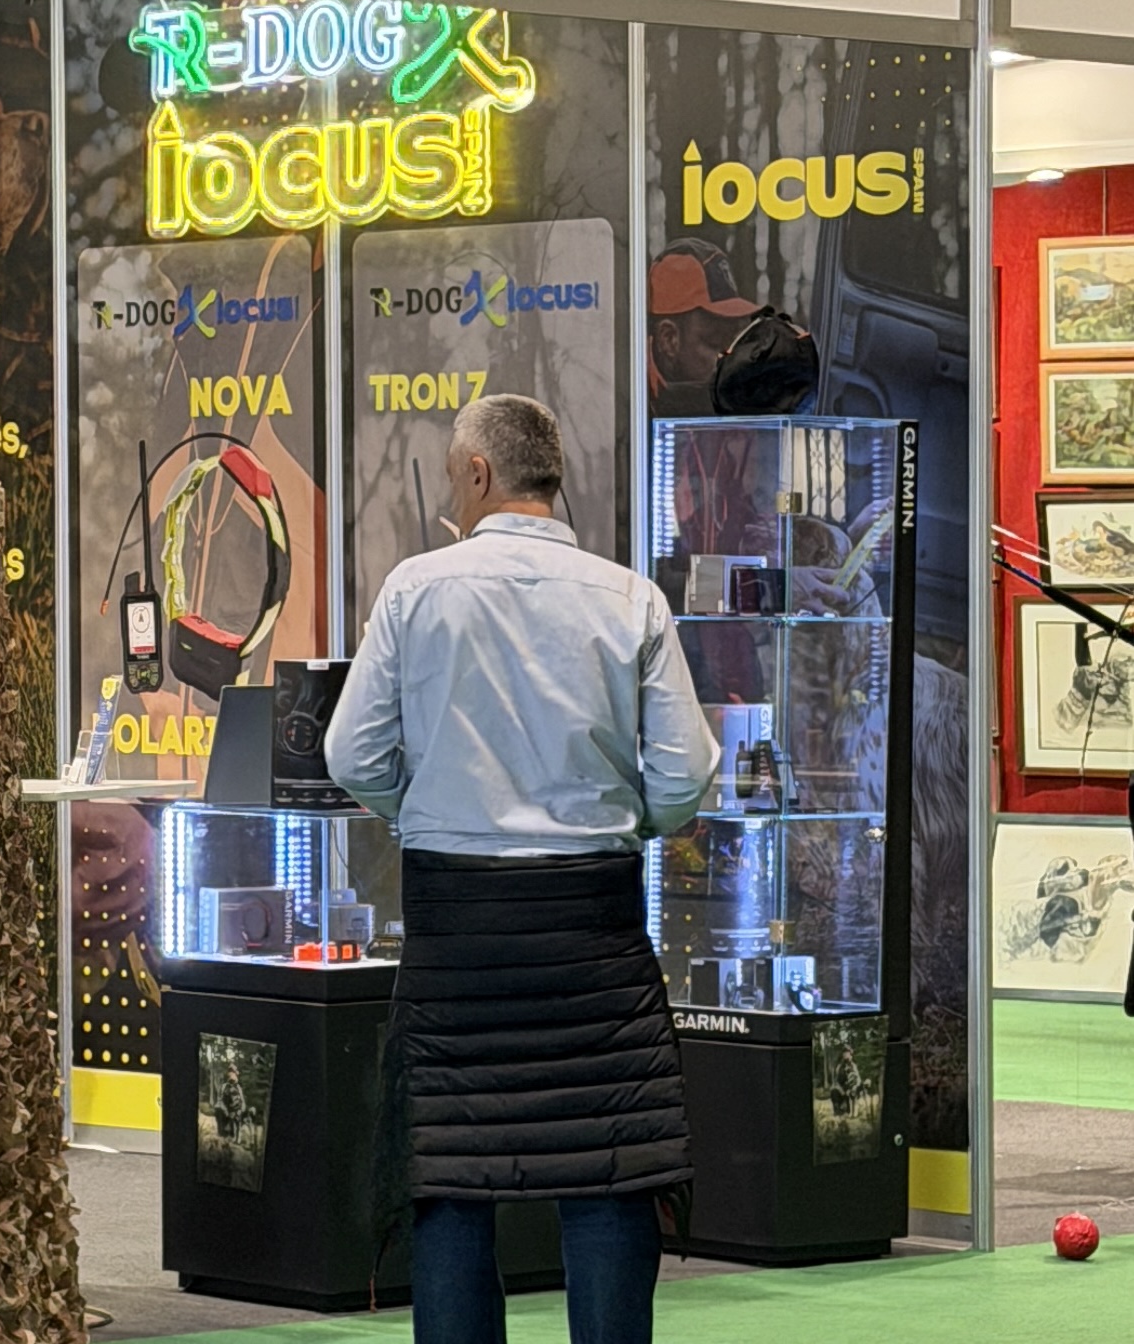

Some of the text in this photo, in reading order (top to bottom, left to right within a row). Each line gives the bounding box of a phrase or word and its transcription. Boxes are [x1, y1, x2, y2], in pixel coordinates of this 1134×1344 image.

[463, 109, 484, 206] SPAIN
[913, 147, 925, 214] SPAIN
[190, 374, 293, 417] NOVA
[369, 372, 459, 411] TRON
[284, 890, 294, 945] GARMIN
